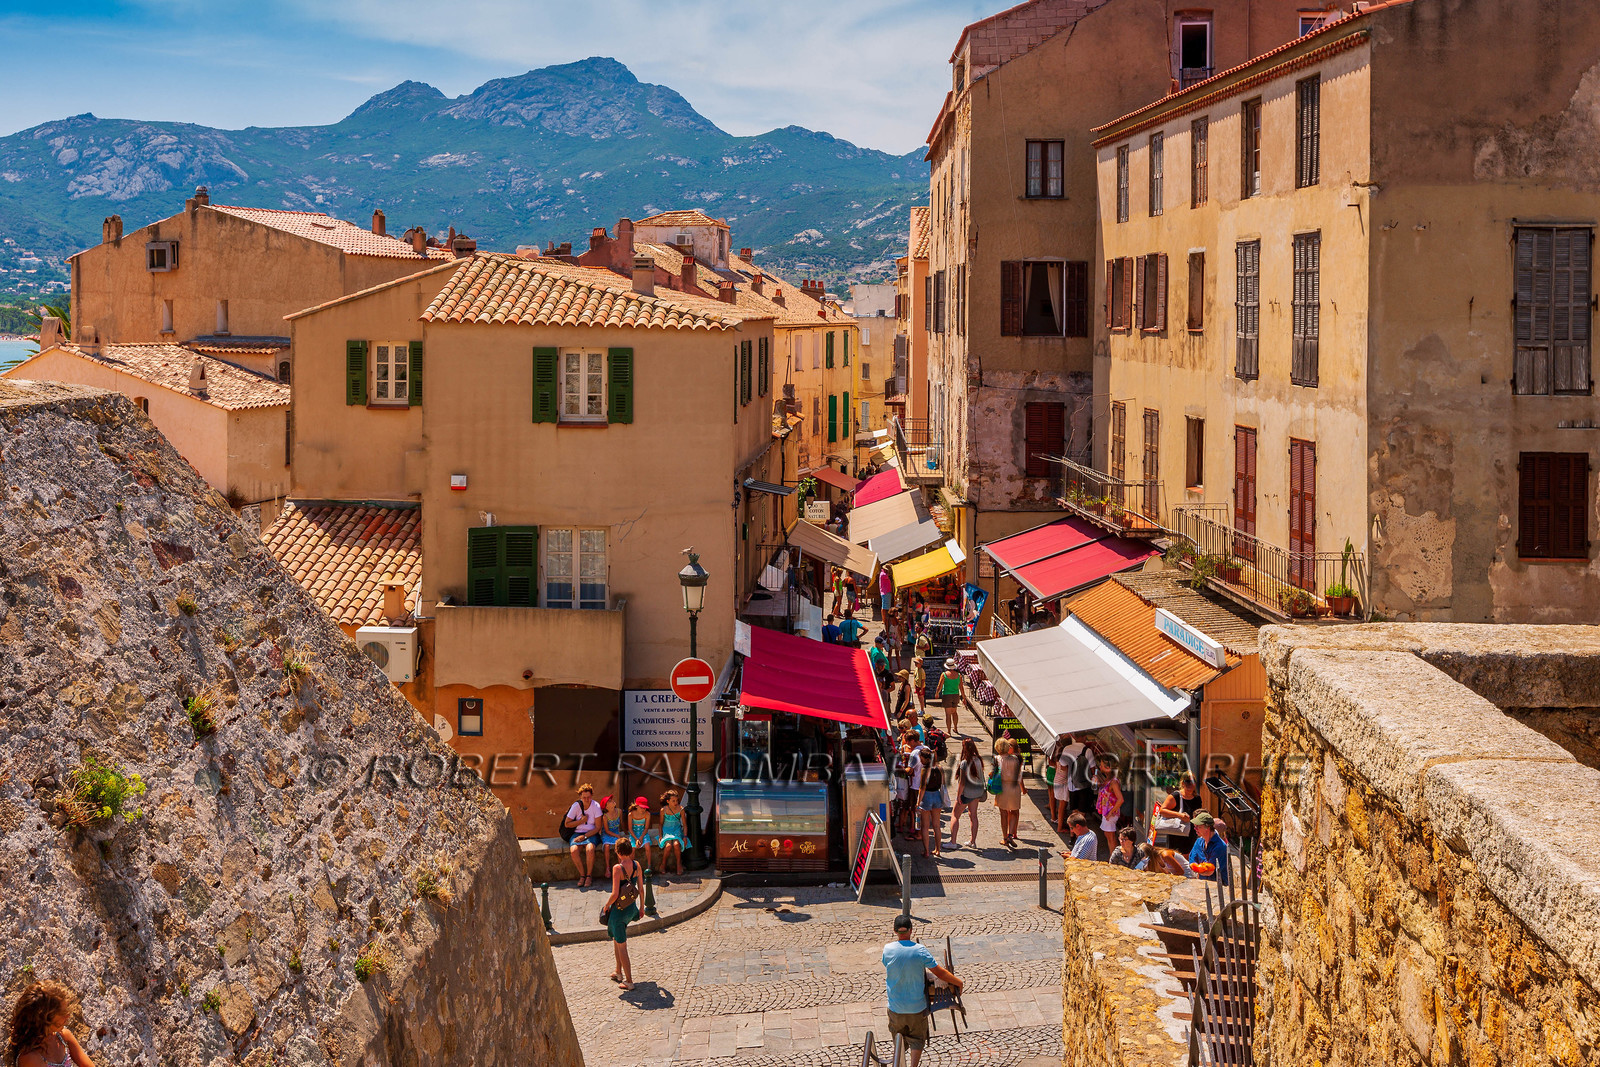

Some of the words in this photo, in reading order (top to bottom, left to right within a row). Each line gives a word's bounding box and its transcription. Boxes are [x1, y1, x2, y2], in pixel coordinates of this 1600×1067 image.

[635, 694, 648, 703] LA
[650, 694, 702, 703] CREP
[729, 840, 748, 854] Art
